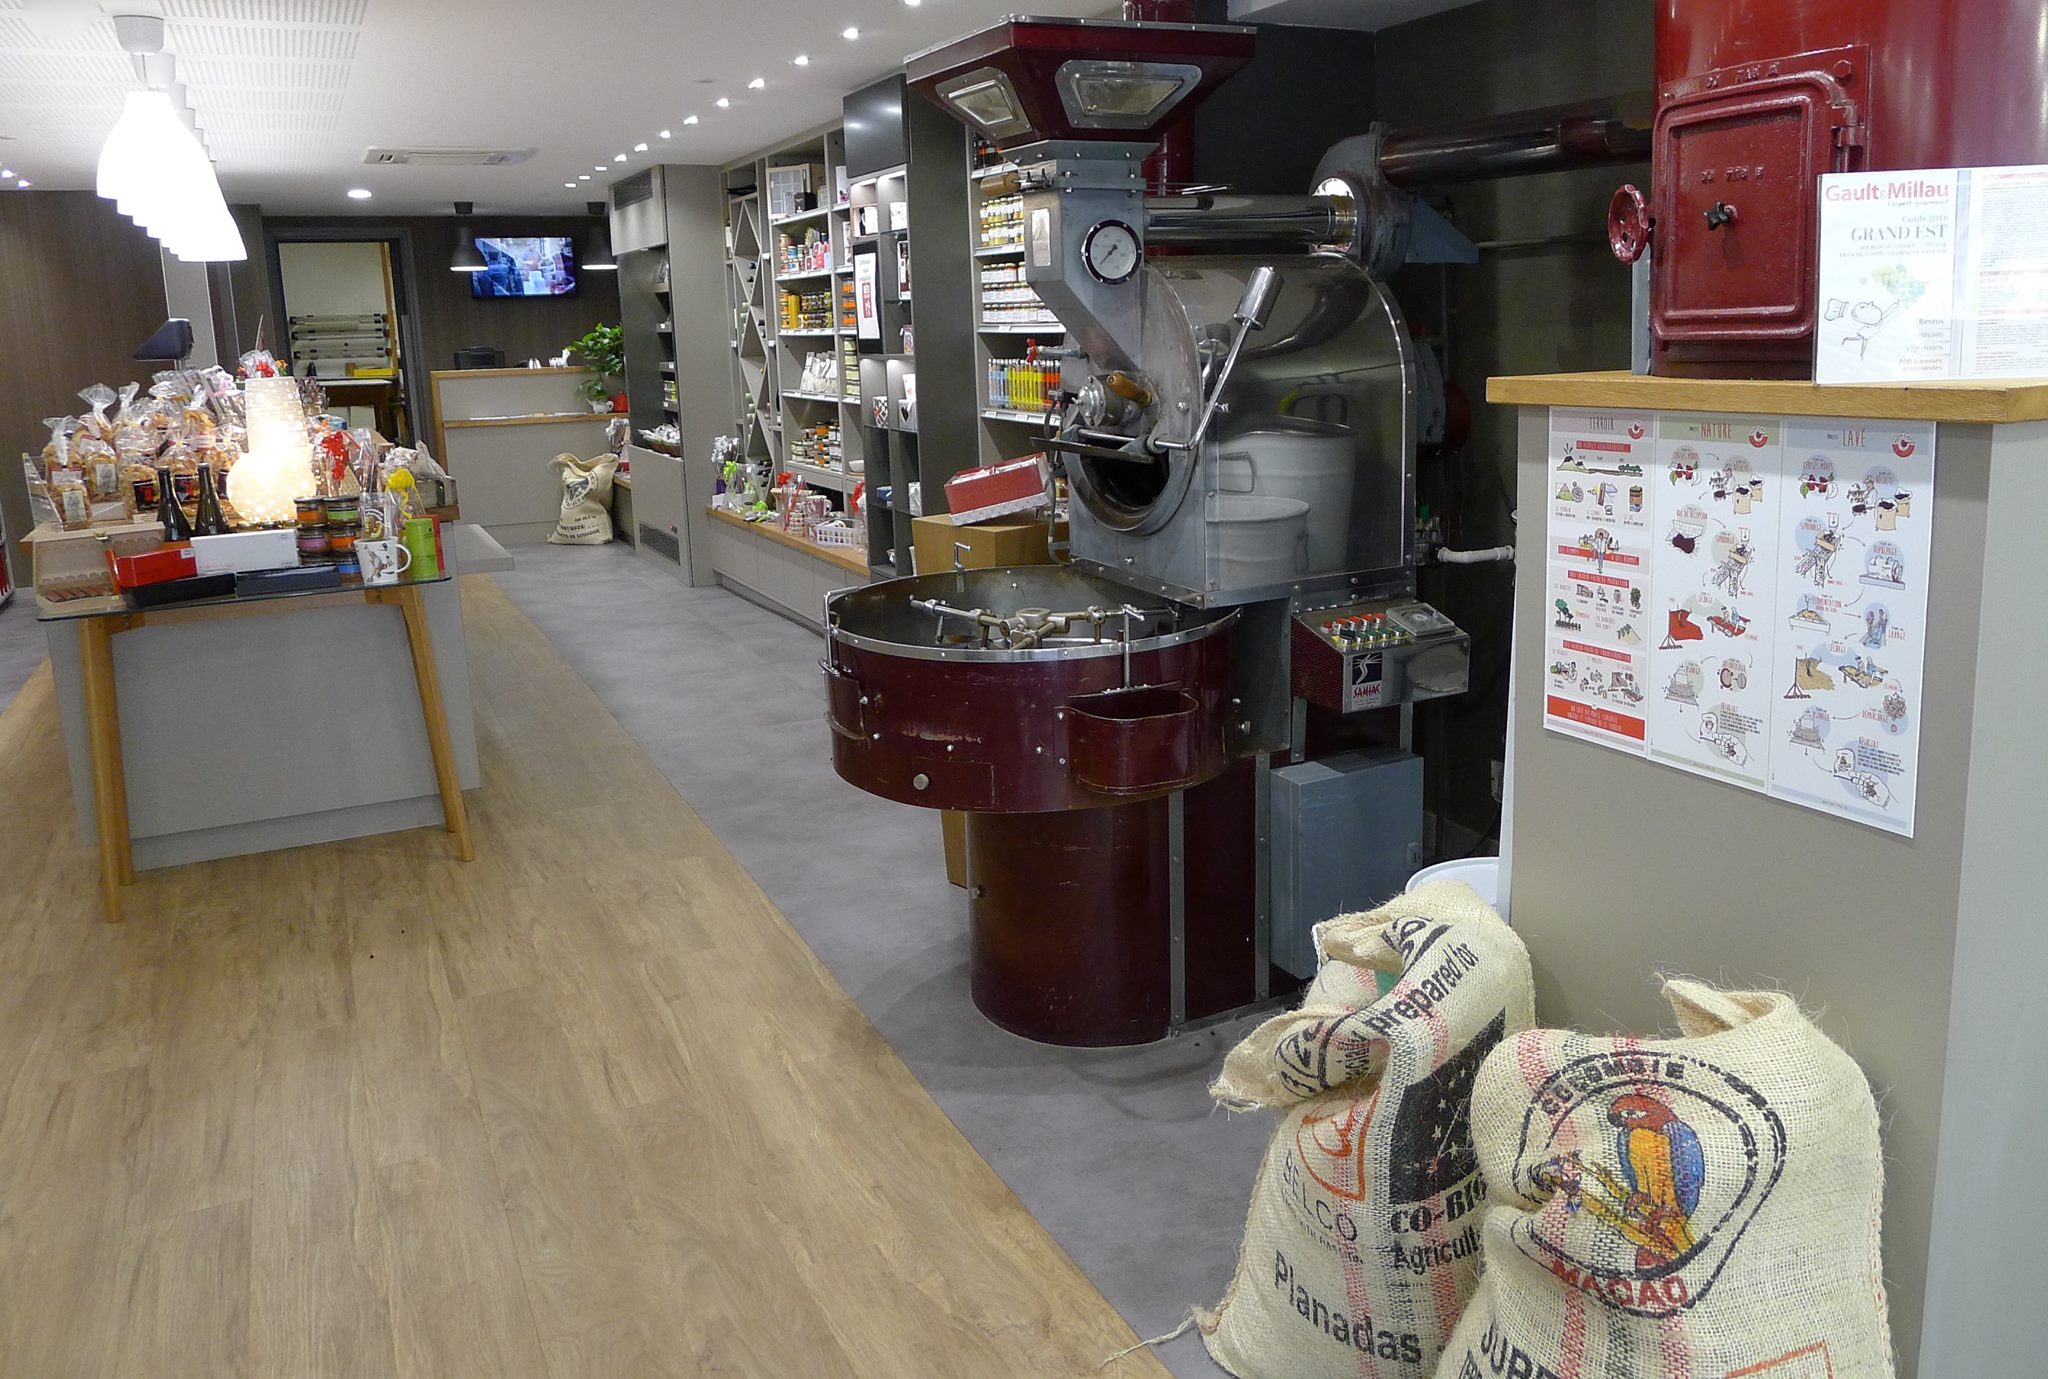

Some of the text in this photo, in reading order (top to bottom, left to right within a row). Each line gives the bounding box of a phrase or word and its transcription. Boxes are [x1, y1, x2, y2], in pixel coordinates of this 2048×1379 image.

[1851, 224, 1949, 241] GRAND EST
[1589, 416, 1614, 431] TERROIR
[1701, 422, 1732, 439] NATURE
[1361, 941, 1481, 1037] prepared for
[1282, 1148, 1359, 1242] BELCO
[1274, 1248, 1423, 1365] Planadas
[1550, 1258, 1689, 1307] MACAO
